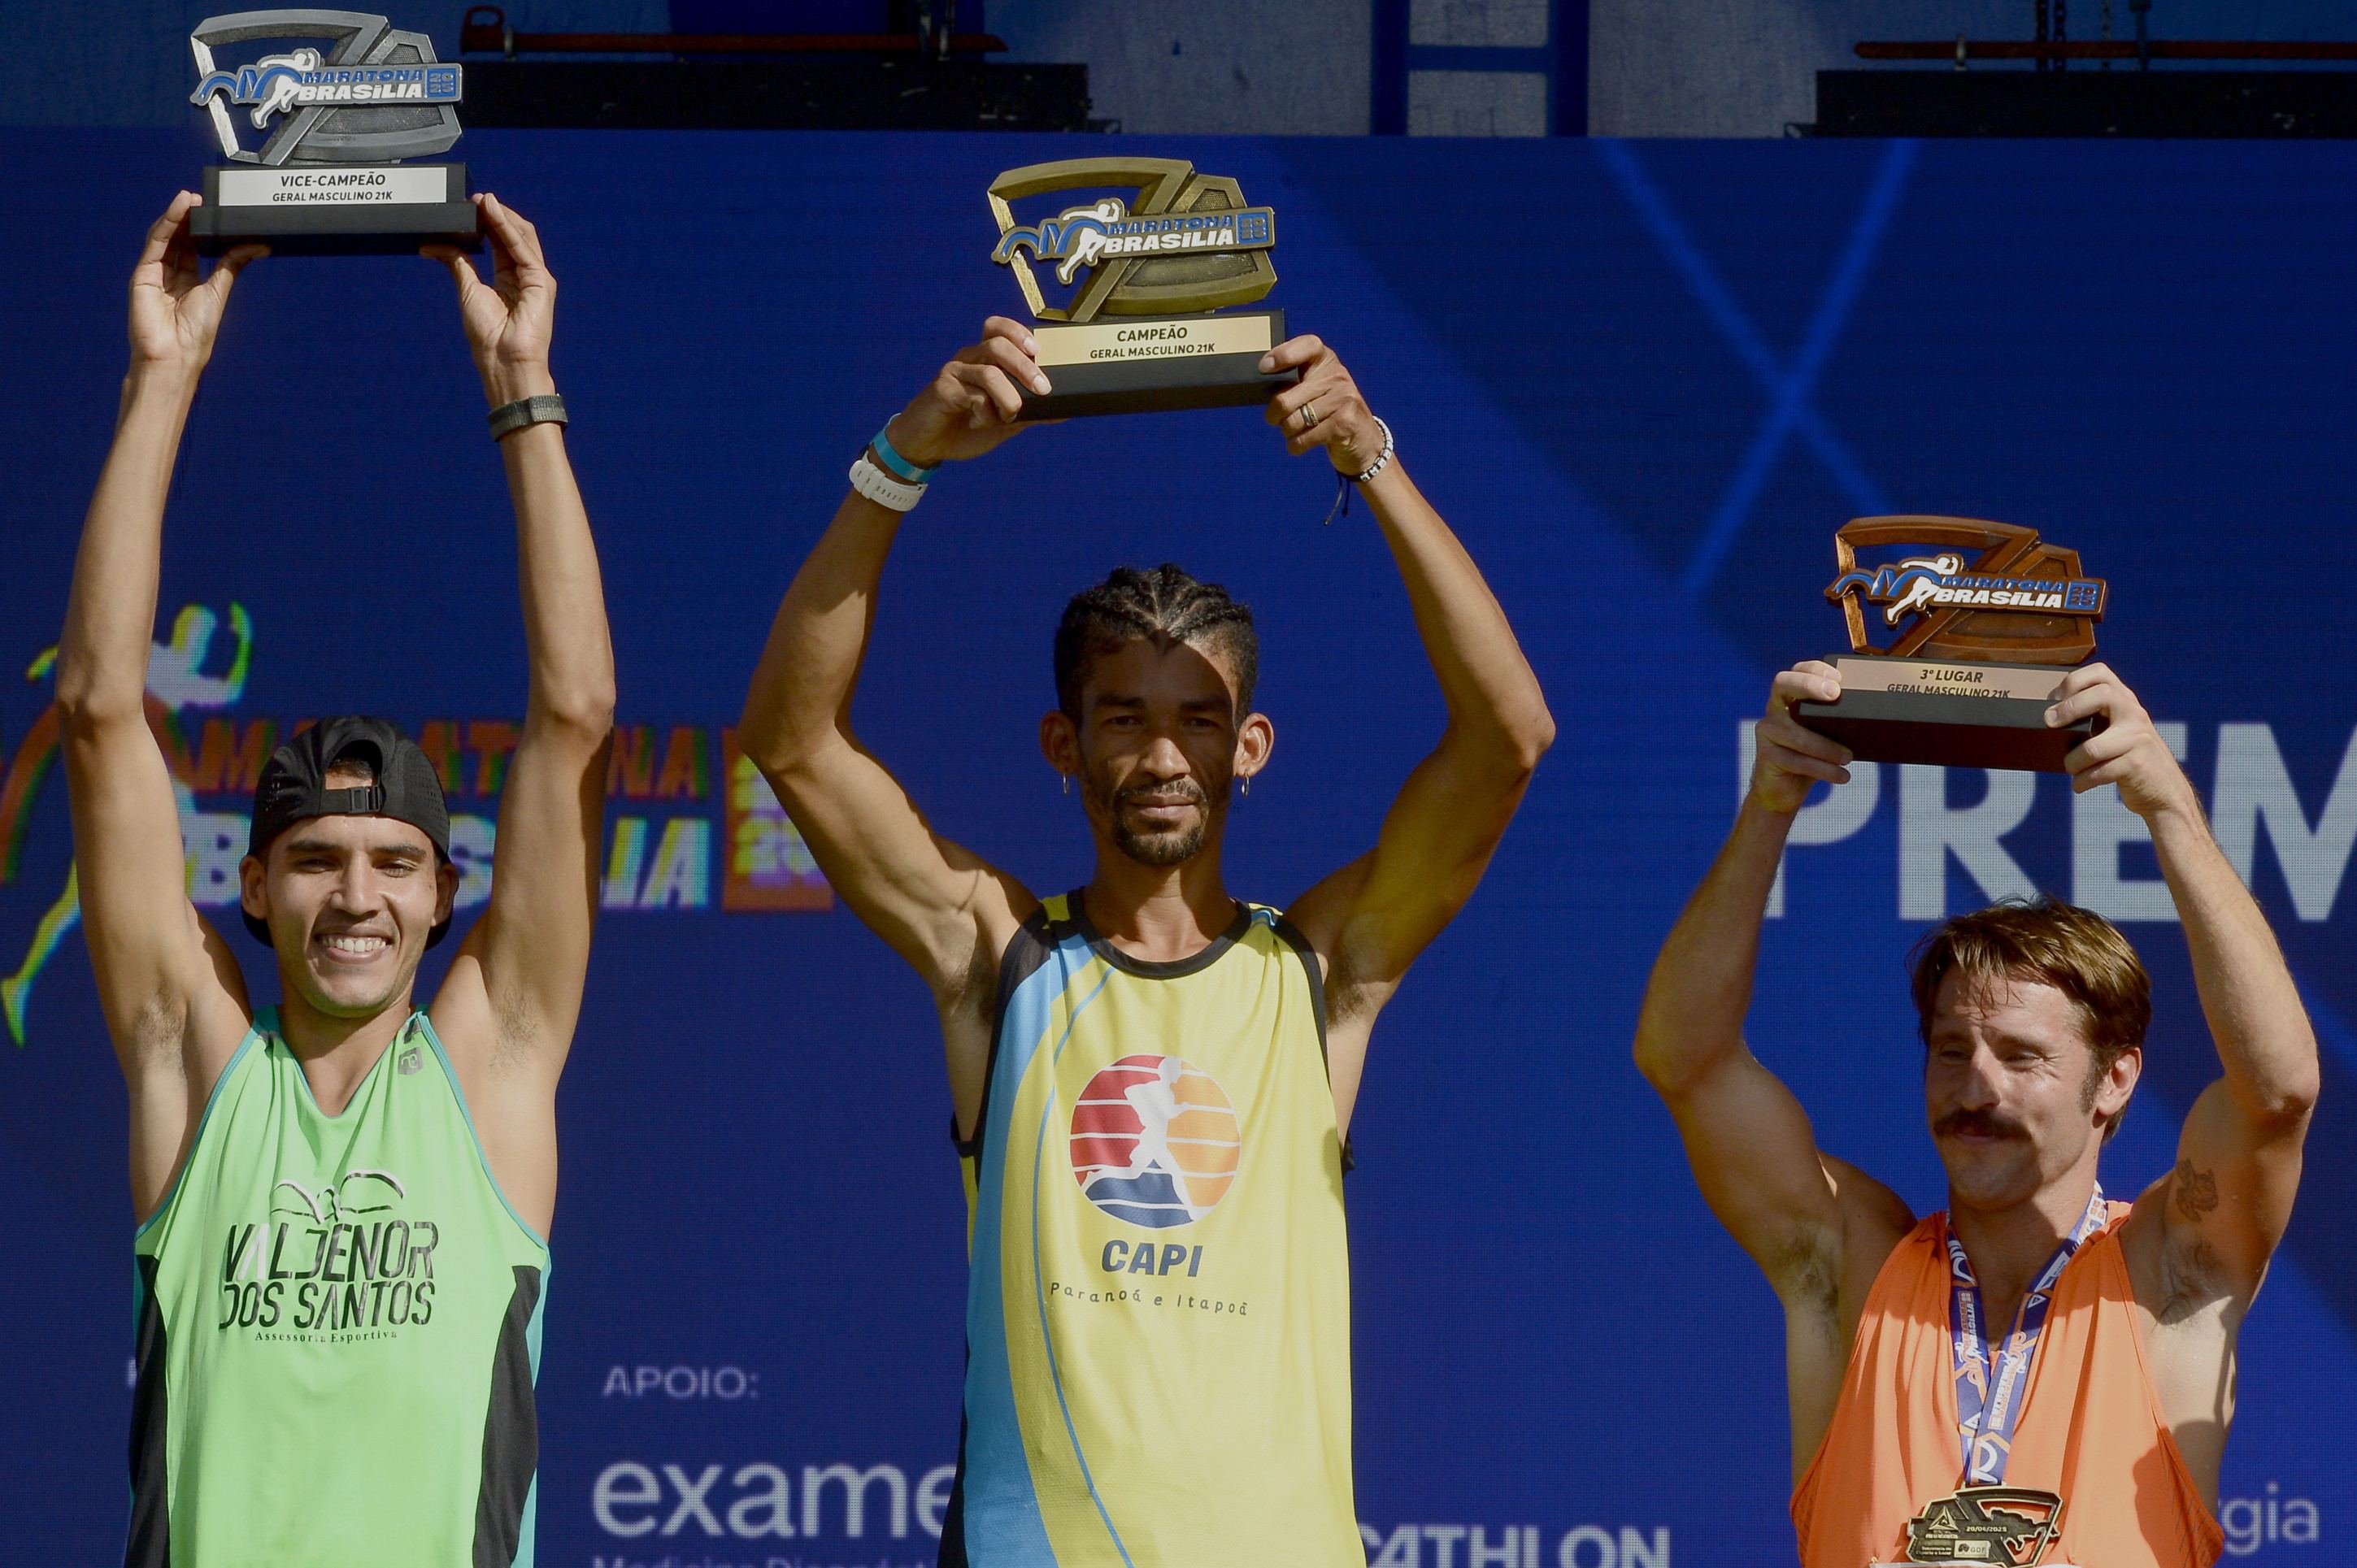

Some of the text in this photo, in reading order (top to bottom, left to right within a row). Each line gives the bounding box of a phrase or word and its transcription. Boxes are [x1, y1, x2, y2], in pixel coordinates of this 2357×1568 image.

[302, 70, 423, 84] MARATONA
[280, 172, 386, 187] VICE-CAMPEÃO
[272, 191, 393, 202] GERAL MASCULINO 21K
[1107, 215, 1233, 234] MARATONA
[1117, 324, 1188, 342] CAMPEÃO
[1089, 343, 1215, 359] GERAL MASCULINO 21K
[1941, 576, 2066, 592] MARATONA
[1935, 670, 1984, 683] LUGAR
[1887, 684, 1921, 694] GERAL
[1992, 689, 2011, 699] 21K
[224, 1220, 439, 1283] VALDENOR
[1102, 1240, 1203, 1277] CAPI
[219, 1281, 436, 1330] DOS SANTOS
[1050, 1282, 1248, 1315] Paranoá e Itapoã
[331, 1330, 397, 1344] Esportiva
[603, 1366, 759, 1399] APOIO:
[2219, 1481, 2320, 1556] gia
